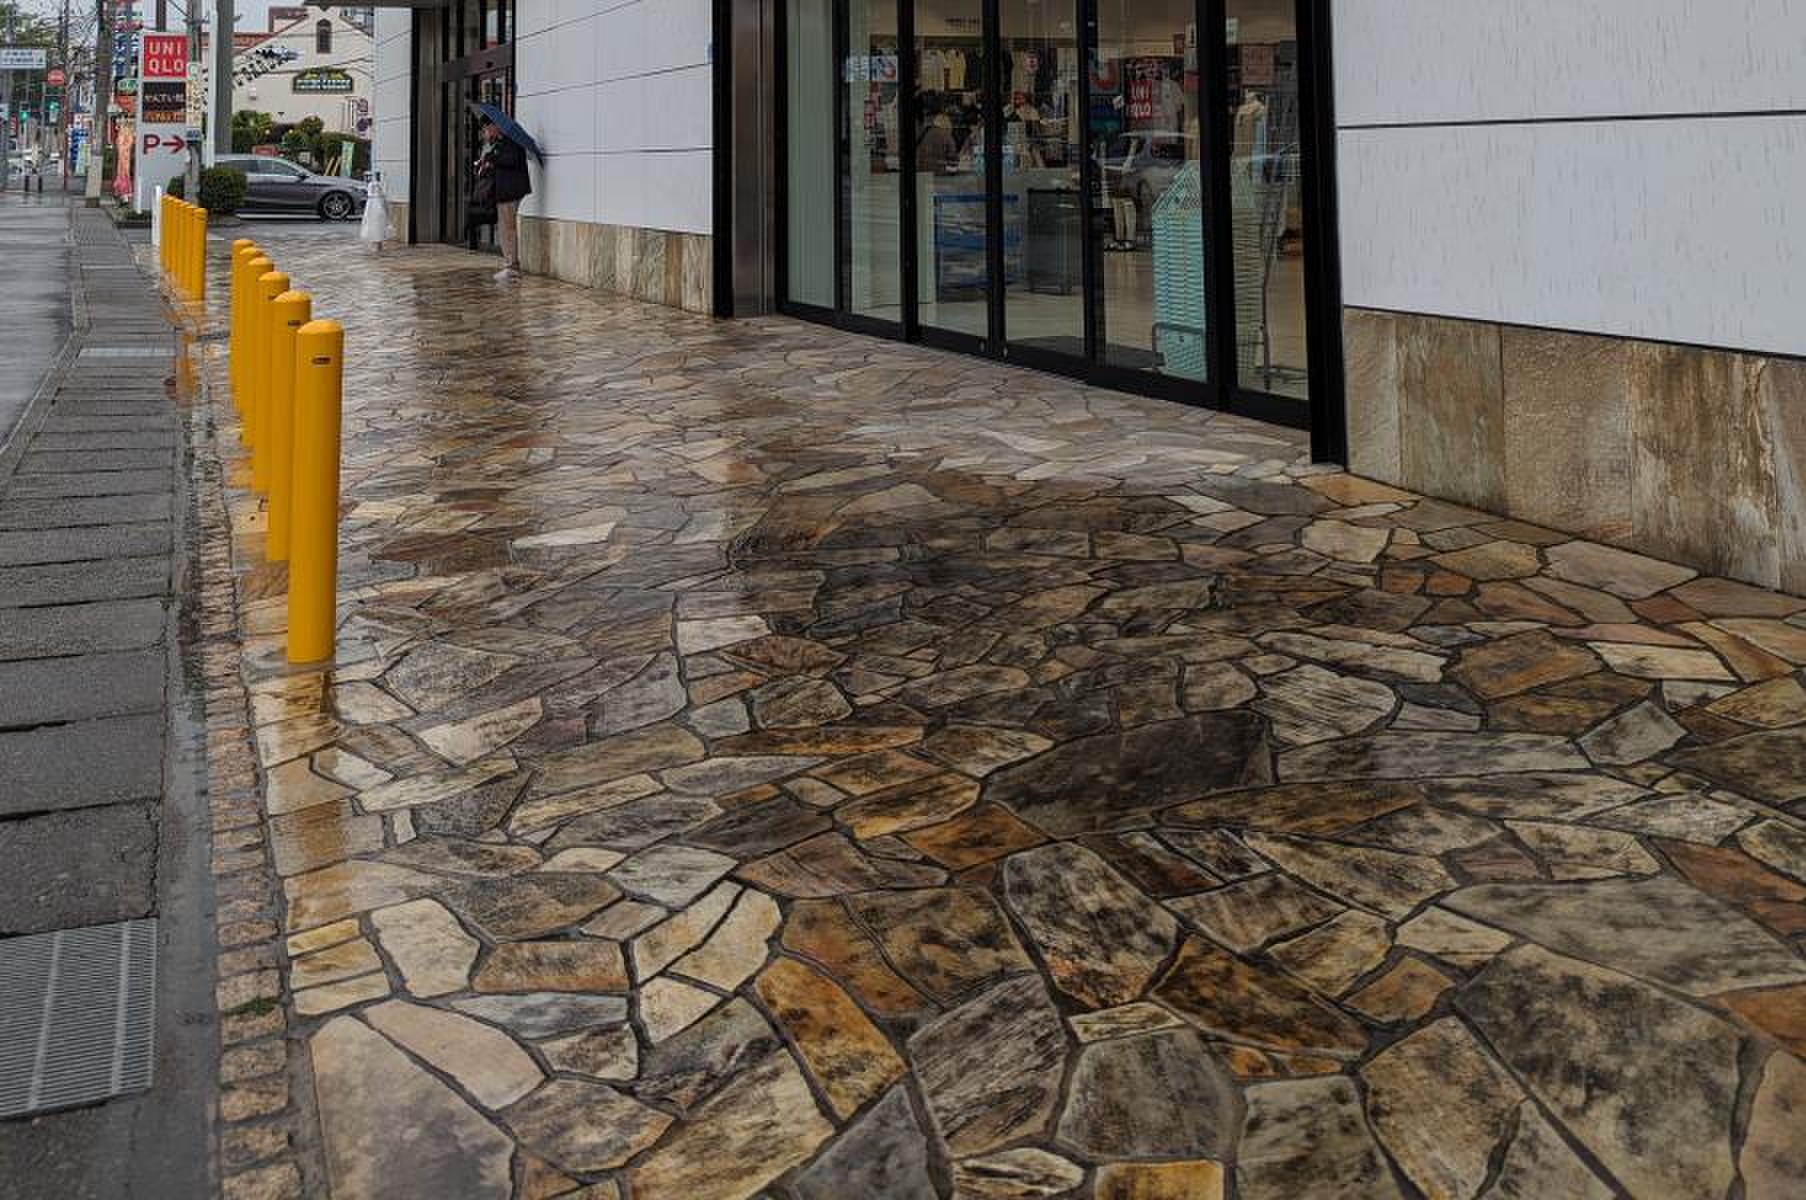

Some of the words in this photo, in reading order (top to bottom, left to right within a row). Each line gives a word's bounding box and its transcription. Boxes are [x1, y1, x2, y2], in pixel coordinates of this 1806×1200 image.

[149, 42, 182, 56] UNI
[149, 59, 184, 74] QLO
[143, 134, 160, 154] P
